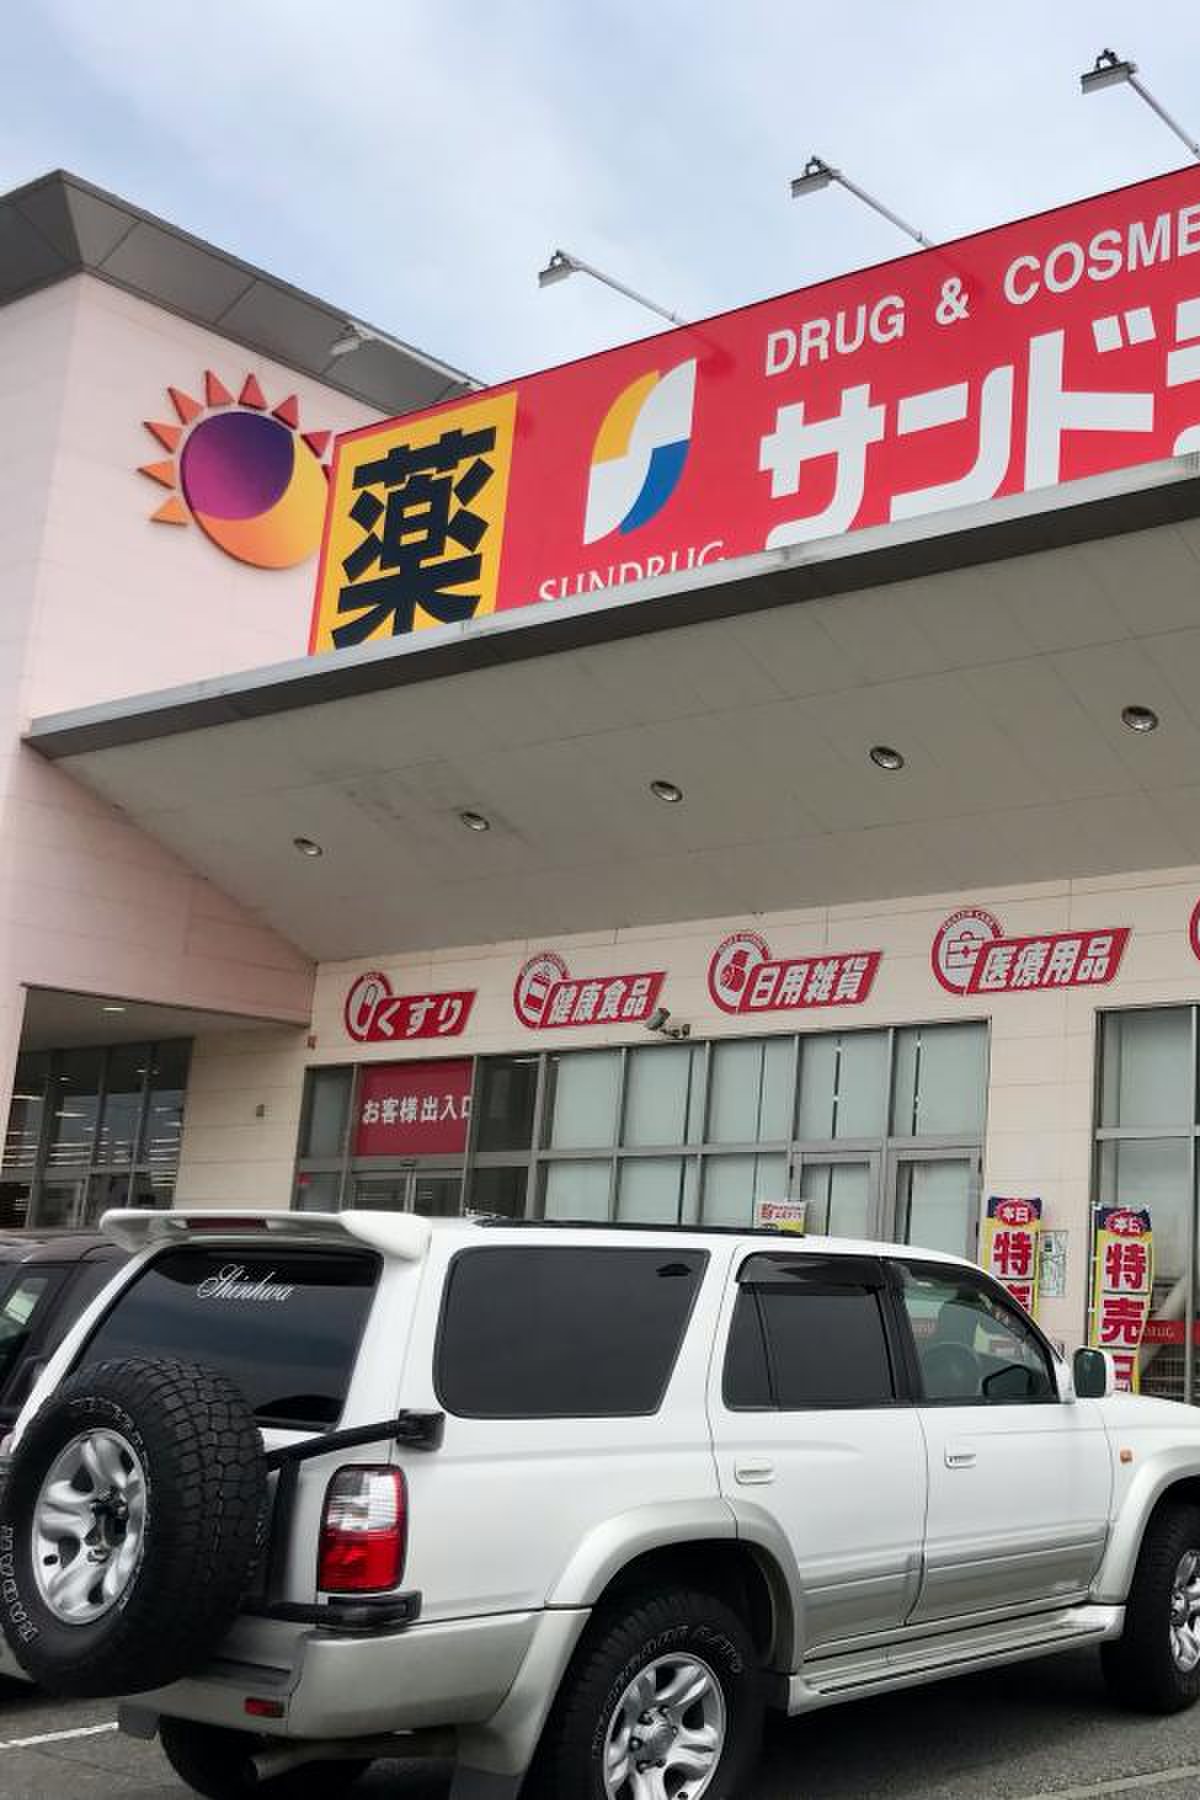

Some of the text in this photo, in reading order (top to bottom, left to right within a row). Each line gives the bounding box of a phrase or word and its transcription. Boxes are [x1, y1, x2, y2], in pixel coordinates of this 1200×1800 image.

[765, 295, 906, 378] DRUG
[935, 276, 970, 327] &
[331, 426, 497, 650] 薬
[750, 958, 871, 1006] 日用雑貨
[978, 935, 1115, 989] 医療用品
[377, 997, 463, 1034] くすり
[549, 977, 650, 1024] 健康食品
